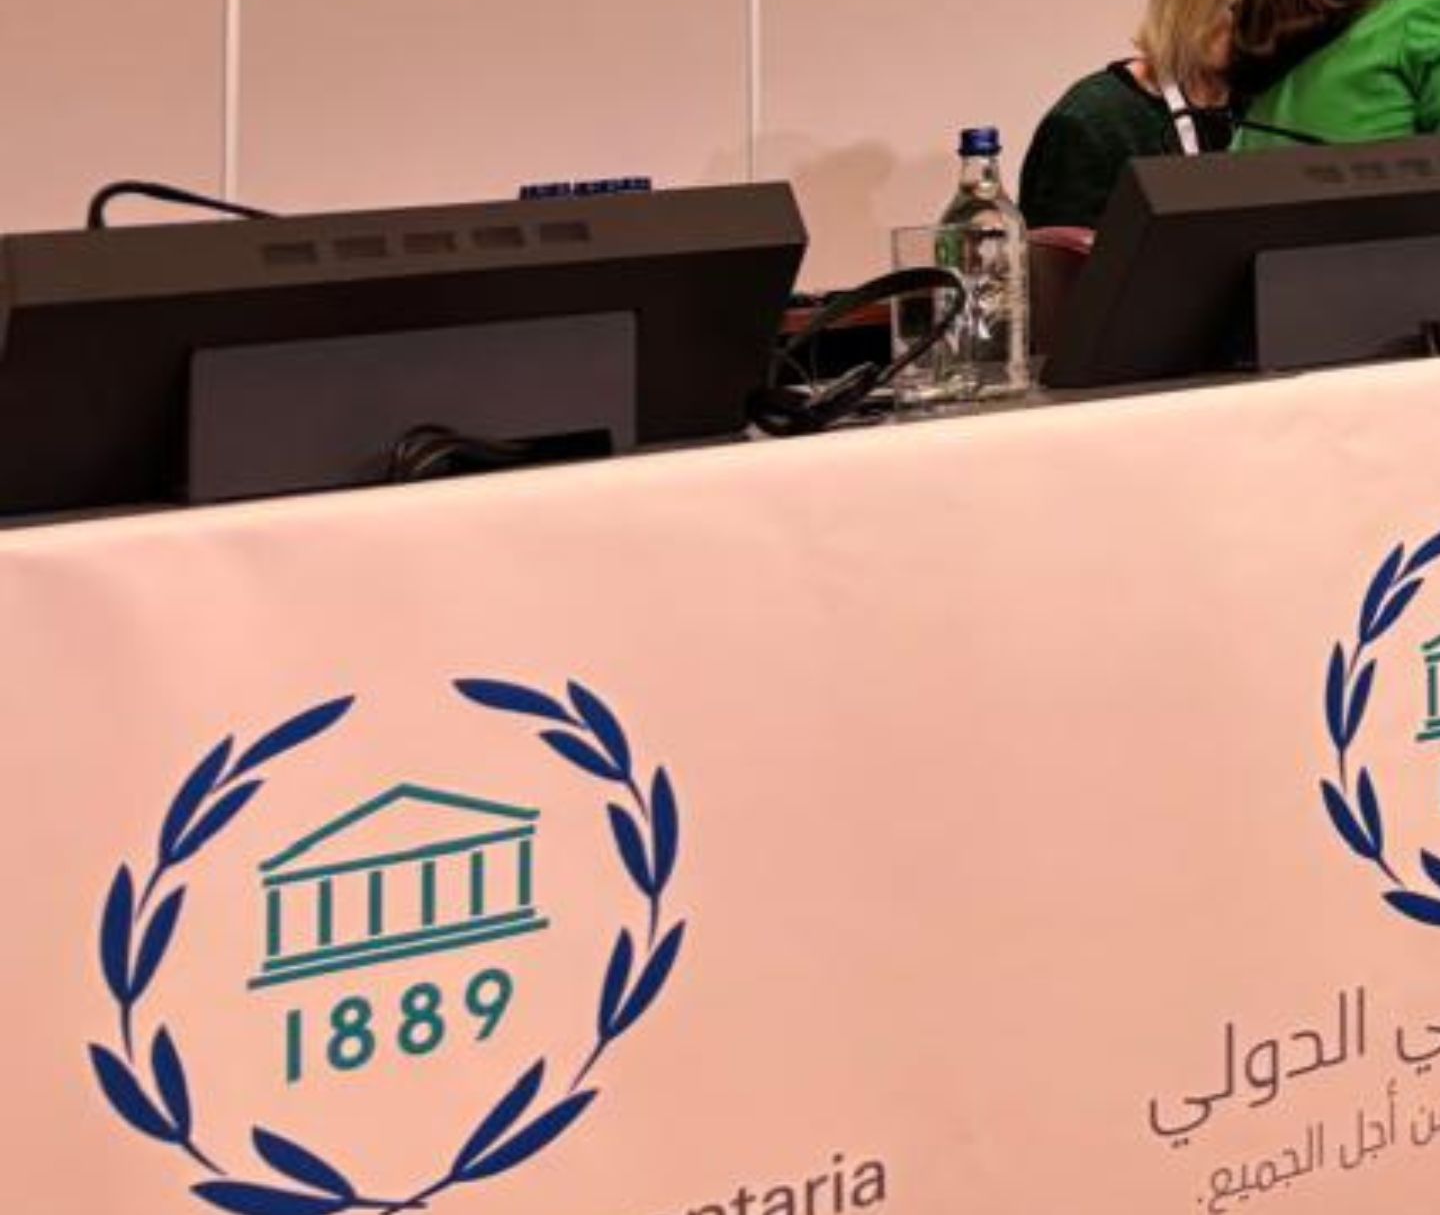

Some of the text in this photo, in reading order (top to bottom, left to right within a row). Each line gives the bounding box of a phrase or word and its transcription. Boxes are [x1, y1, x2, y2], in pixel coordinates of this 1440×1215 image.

[286, 968, 513, 1083] 1889
[1149, 986, 1366, 1150] الدولي
[1339, 1077, 1397, 1170] أجل
